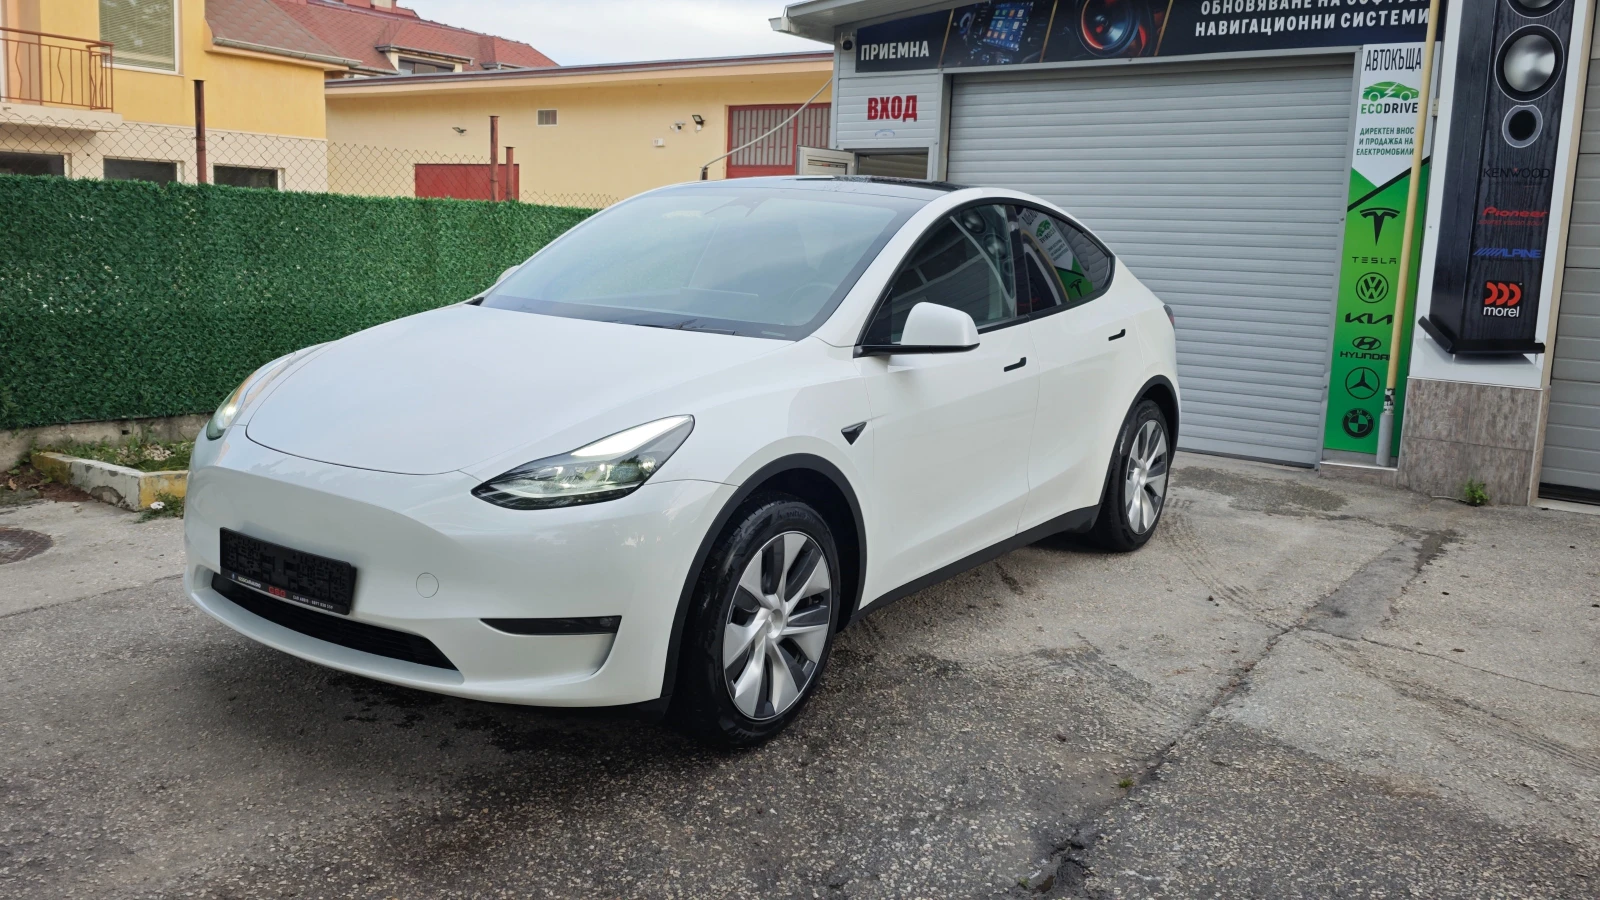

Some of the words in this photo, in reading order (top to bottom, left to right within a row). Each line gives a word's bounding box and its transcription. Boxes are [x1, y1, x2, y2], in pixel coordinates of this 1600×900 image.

[1201, 0, 1312, 15] ОБНОВЯВАНЕ
[1195, 13, 1335, 37] НАВИГАЦИОННИ
[1340, 8, 1430, 28] СИСТЕМИ
[860, 40, 930, 61] ПРИЕМНА
[1364, 48, 1422, 72] АВТОКЪЩА
[867, 95, 917, 122] ВХОД
[1361, 102, 1418, 114] ECODRIVE
[1360, 127, 1395, 135] ДИРЕКТЕН
[1396, 126, 1415, 134] ВНОС
[1365, 137, 1403, 146] ПРОДАЖБА
[1404, 137, 1413, 145] НА
[1356, 148, 1414, 156] ЕЛЕКТРОМОБИЛИ
[1483, 167, 1551, 179] KENWOOD
[1482, 206, 1548, 218] Pioneer
[1474, 247, 1542, 259] ALPINE
[1352, 256, 1397, 265] TESLA
[1483, 306, 1520, 318] morel
